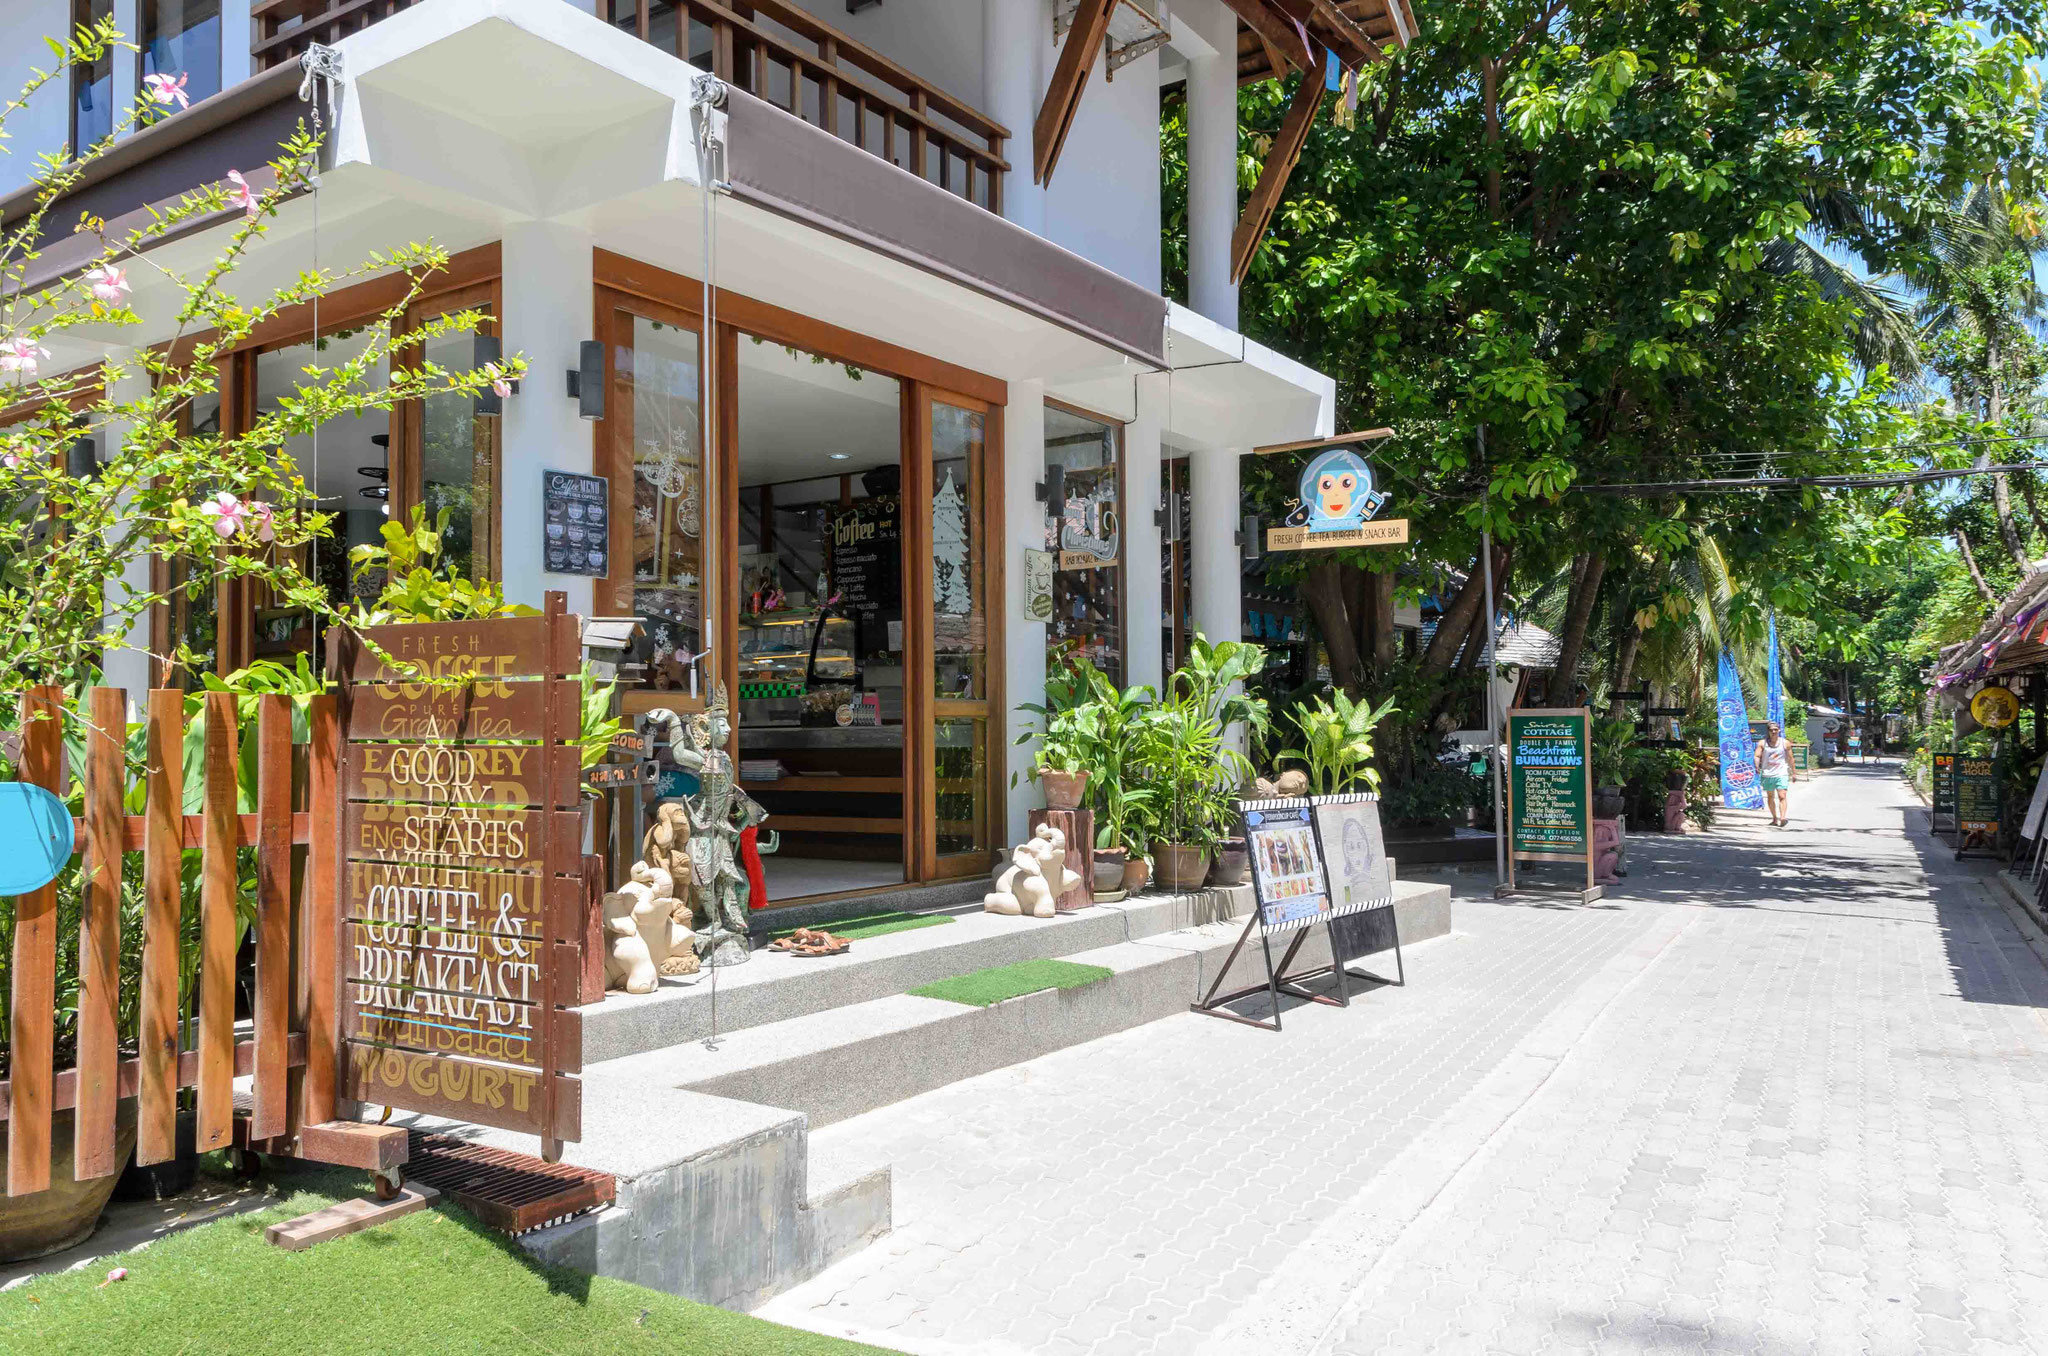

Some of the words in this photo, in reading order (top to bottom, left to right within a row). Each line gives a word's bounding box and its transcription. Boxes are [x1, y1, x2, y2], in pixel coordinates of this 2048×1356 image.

[552, 475, 579, 496] Coffee
[835, 516, 875, 546] Coffee
[879, 520, 892, 528] HOT
[1274, 534, 1292, 545] FRESH
[1294, 533, 1318, 544] COFFEE
[1332, 530, 1357, 541] BURGER
[1364, 528, 1386, 539] SNACK
[1388, 527, 1401, 538] BAR
[836, 547, 858, 555] Espresso
[837, 565, 862, 574] Americano
[1026, 555, 1034, 577] Coffee
[402, 635, 480, 654] FRESH
[375, 654, 517, 703] COFFEE
[410, 704, 459, 715] PURE
[380, 704, 459, 738] Green
[467, 706, 525, 738] Tea
[1523, 728, 1572, 736] COTTAGE
[1517, 745, 1576, 756] Beachfront
[390, 748, 475, 785] GOOD
[1516, 756, 1582, 766] BUNGALOWS
[1960, 760, 1995, 769] HAPPY
[1552, 776, 1568, 784] Fridge
[1961, 768, 1993, 776] HOUR
[425, 784, 492, 821] DAY
[1730, 785, 1762, 802] PADI
[404, 816, 525, 859] STARTS
[376, 848, 470, 890] WITH
[368, 884, 479, 954] COFFEE
[492, 893, 530, 958] &
[354, 945, 539, 1029] BREAKFAST
[436, 1009, 536, 1063] Salad
[353, 1048, 537, 1112] YOGURT
